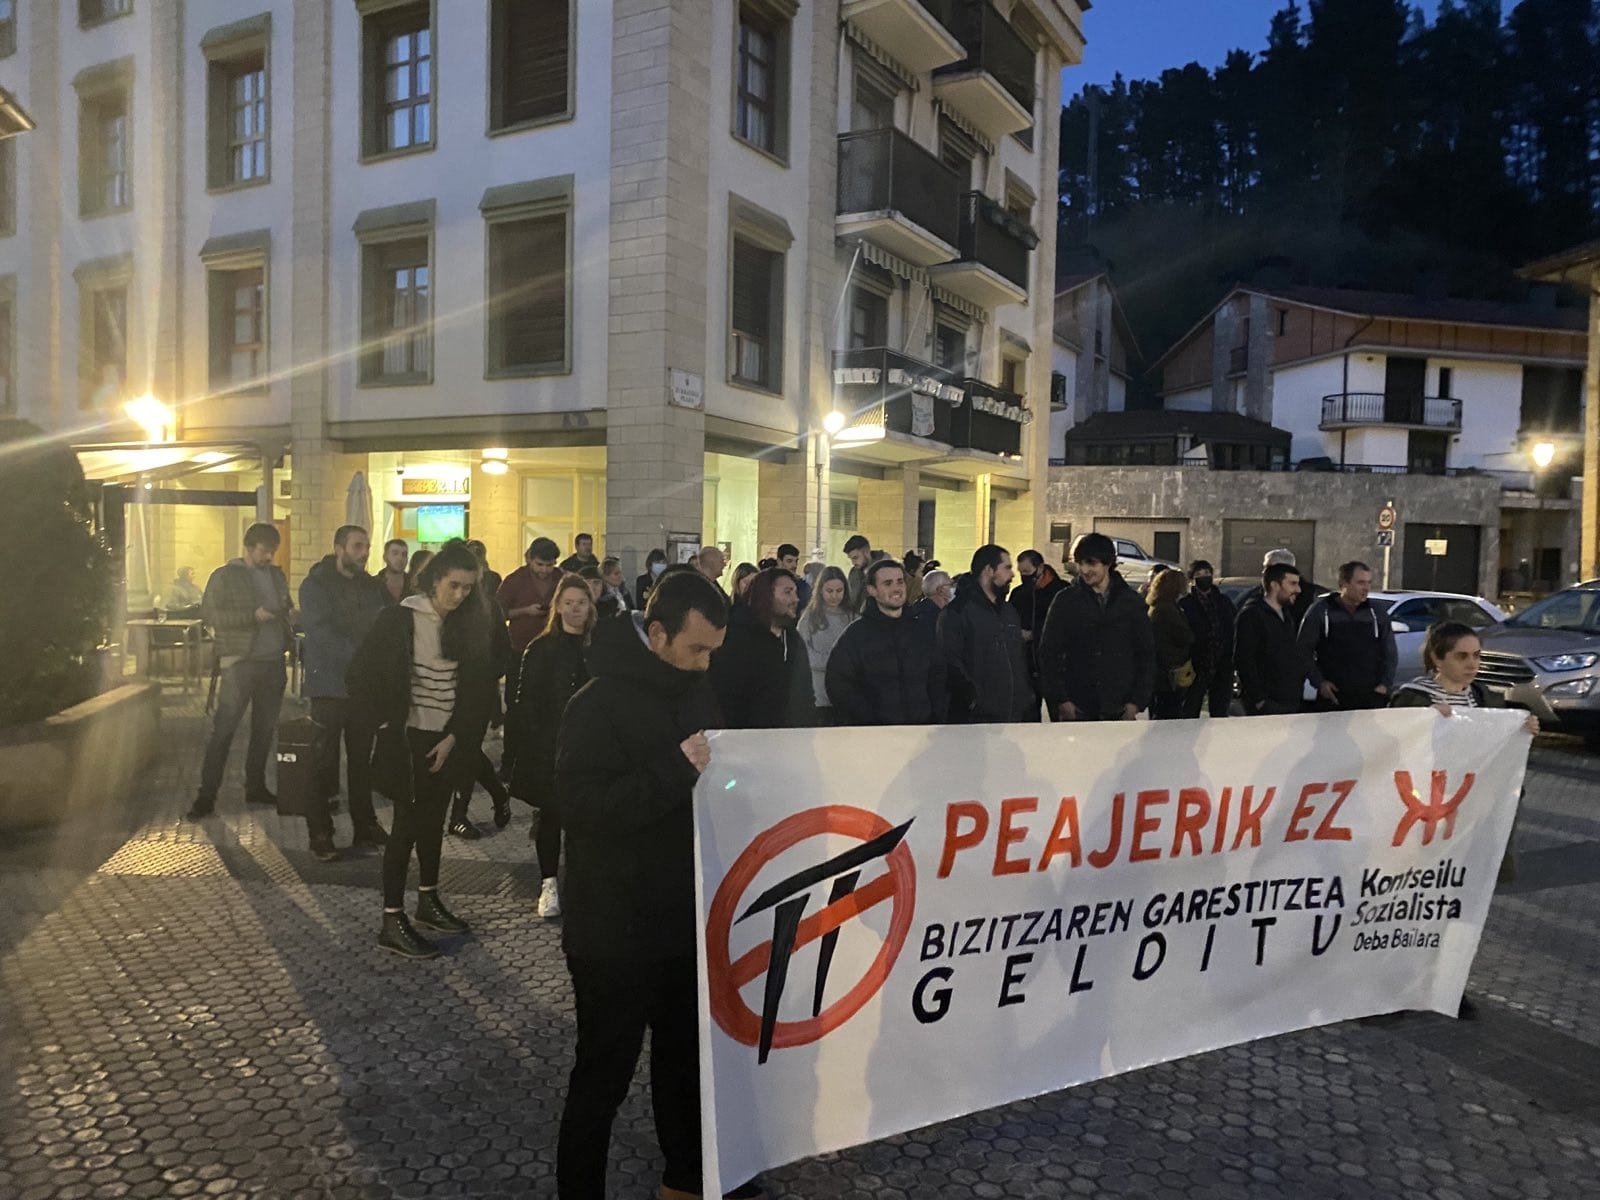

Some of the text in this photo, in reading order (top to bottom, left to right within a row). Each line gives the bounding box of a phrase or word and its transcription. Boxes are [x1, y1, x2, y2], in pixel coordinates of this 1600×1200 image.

[937, 780, 1358, 879] PEAJERIK EZ
[1361, 858, 1466, 897] Kontseilu
[920, 876, 1344, 961] BIZITZAREN GARESTITZEA
[1350, 892, 1461, 926] Sozialista
[1353, 928, 1441, 952] Deba Bailara
